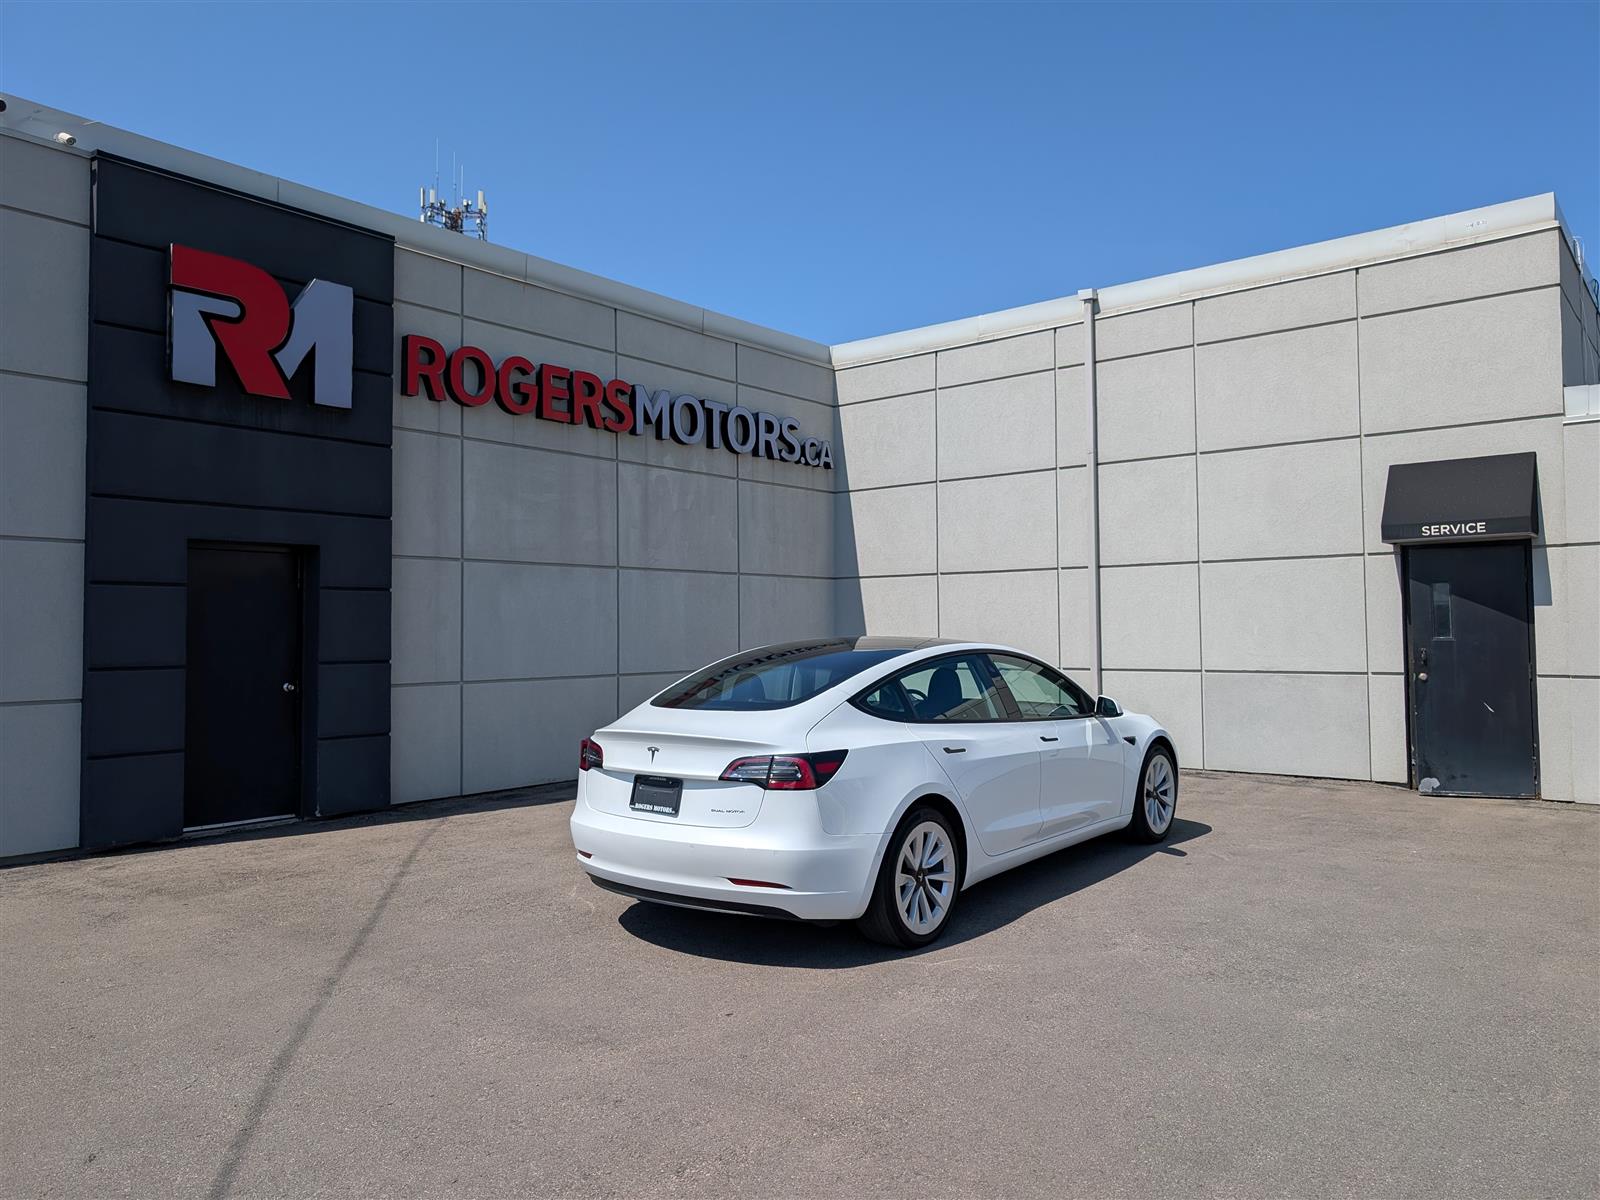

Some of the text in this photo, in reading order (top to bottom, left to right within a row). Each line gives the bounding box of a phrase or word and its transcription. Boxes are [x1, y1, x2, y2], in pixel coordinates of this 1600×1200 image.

[169, 243, 354, 409] RM
[1421, 522, 1487, 536] SERVICE
[634, 803, 654, 811] ROGERS
